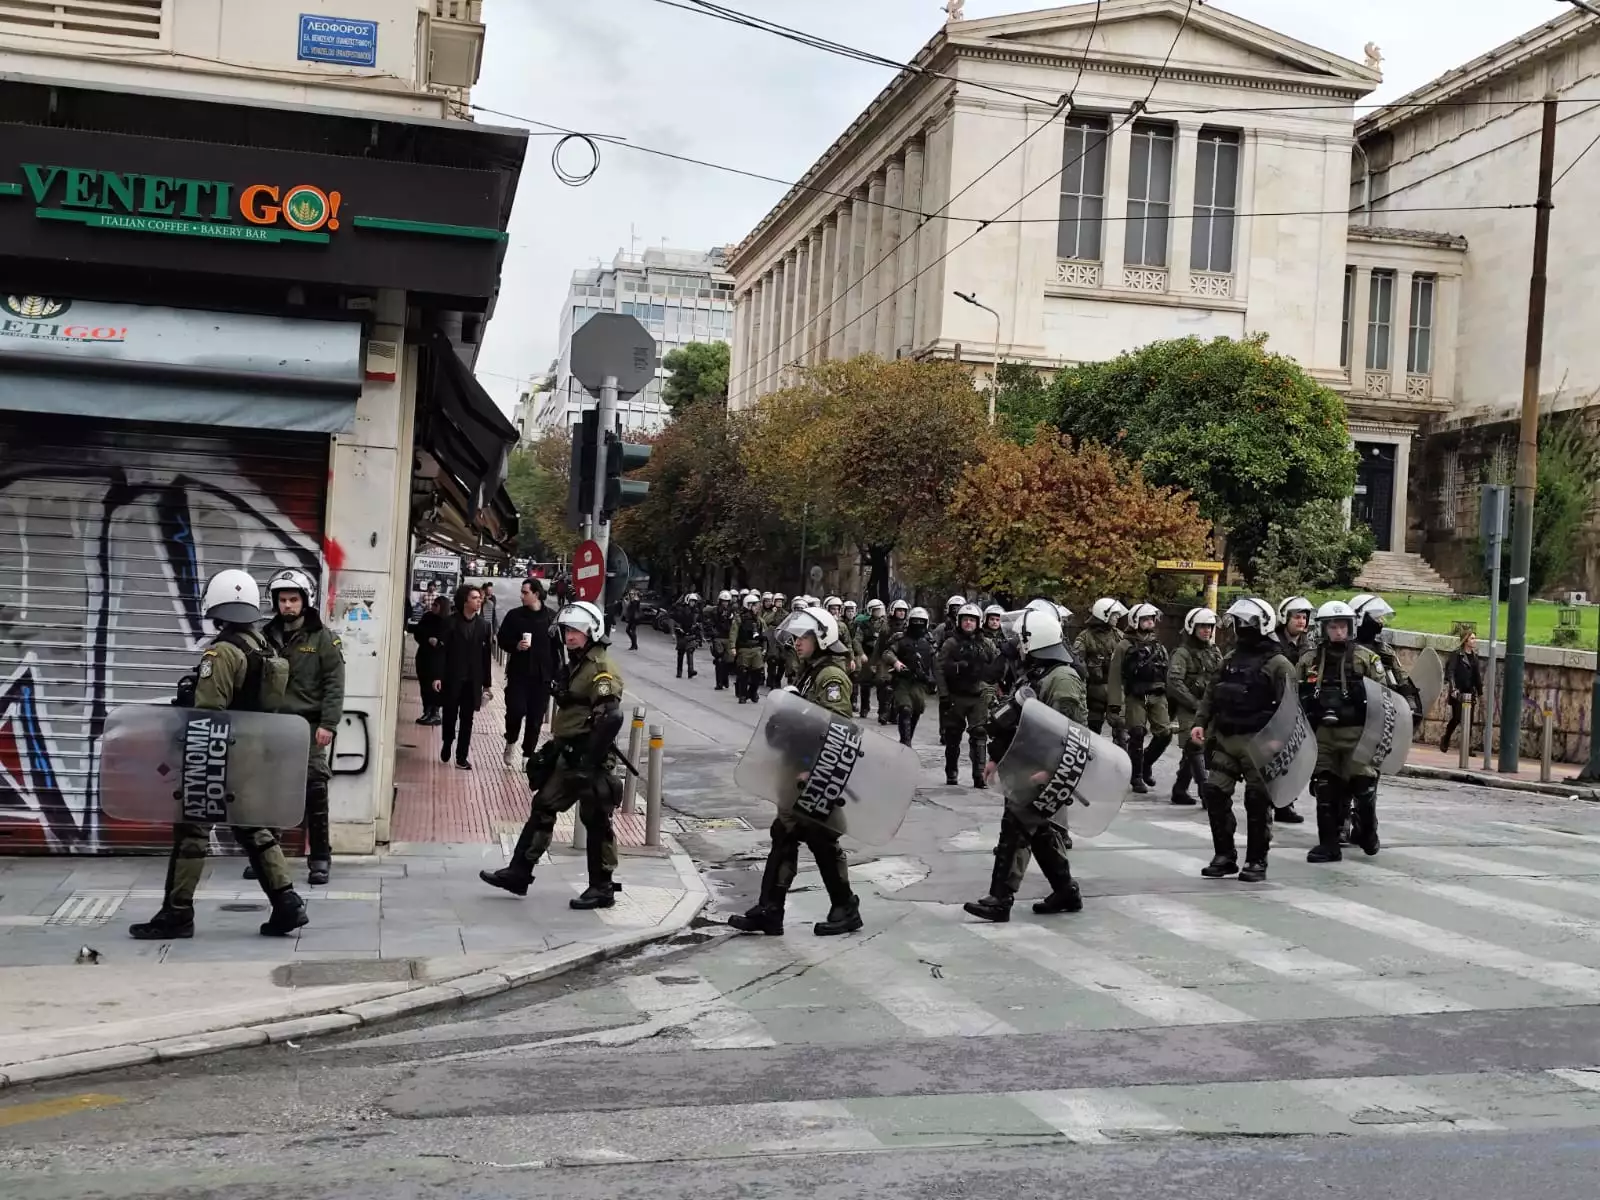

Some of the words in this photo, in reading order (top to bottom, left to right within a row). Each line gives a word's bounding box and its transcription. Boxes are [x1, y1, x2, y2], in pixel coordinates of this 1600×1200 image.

[307, 21, 369, 36] ΛΕΩΦΟΡΟΣ
[20, 163, 234, 220] VENETI
[240, 184, 341, 232] GO!
[100, 215, 147, 228] ITALIAN
[147, 220, 190, 232] COFFEE
[200, 224, 242, 237] BAKERY
[245, 228, 267, 239] BAR
[0, 319, 62, 336] ETI
[64, 325, 128, 339] GO!
[184, 717, 211, 819] ΑΣΤΥΝΟΜΙΑ
[206, 723, 230, 816] POLICE
[798, 721, 849, 813] ΑΣΤΥΝΟΜΙΑ
[815, 731, 862, 816] POLICE
[1032, 725, 1081, 811] ΑΣΤΥΝΟΜΙΑ
[1045, 732, 1090, 813] POLICE
